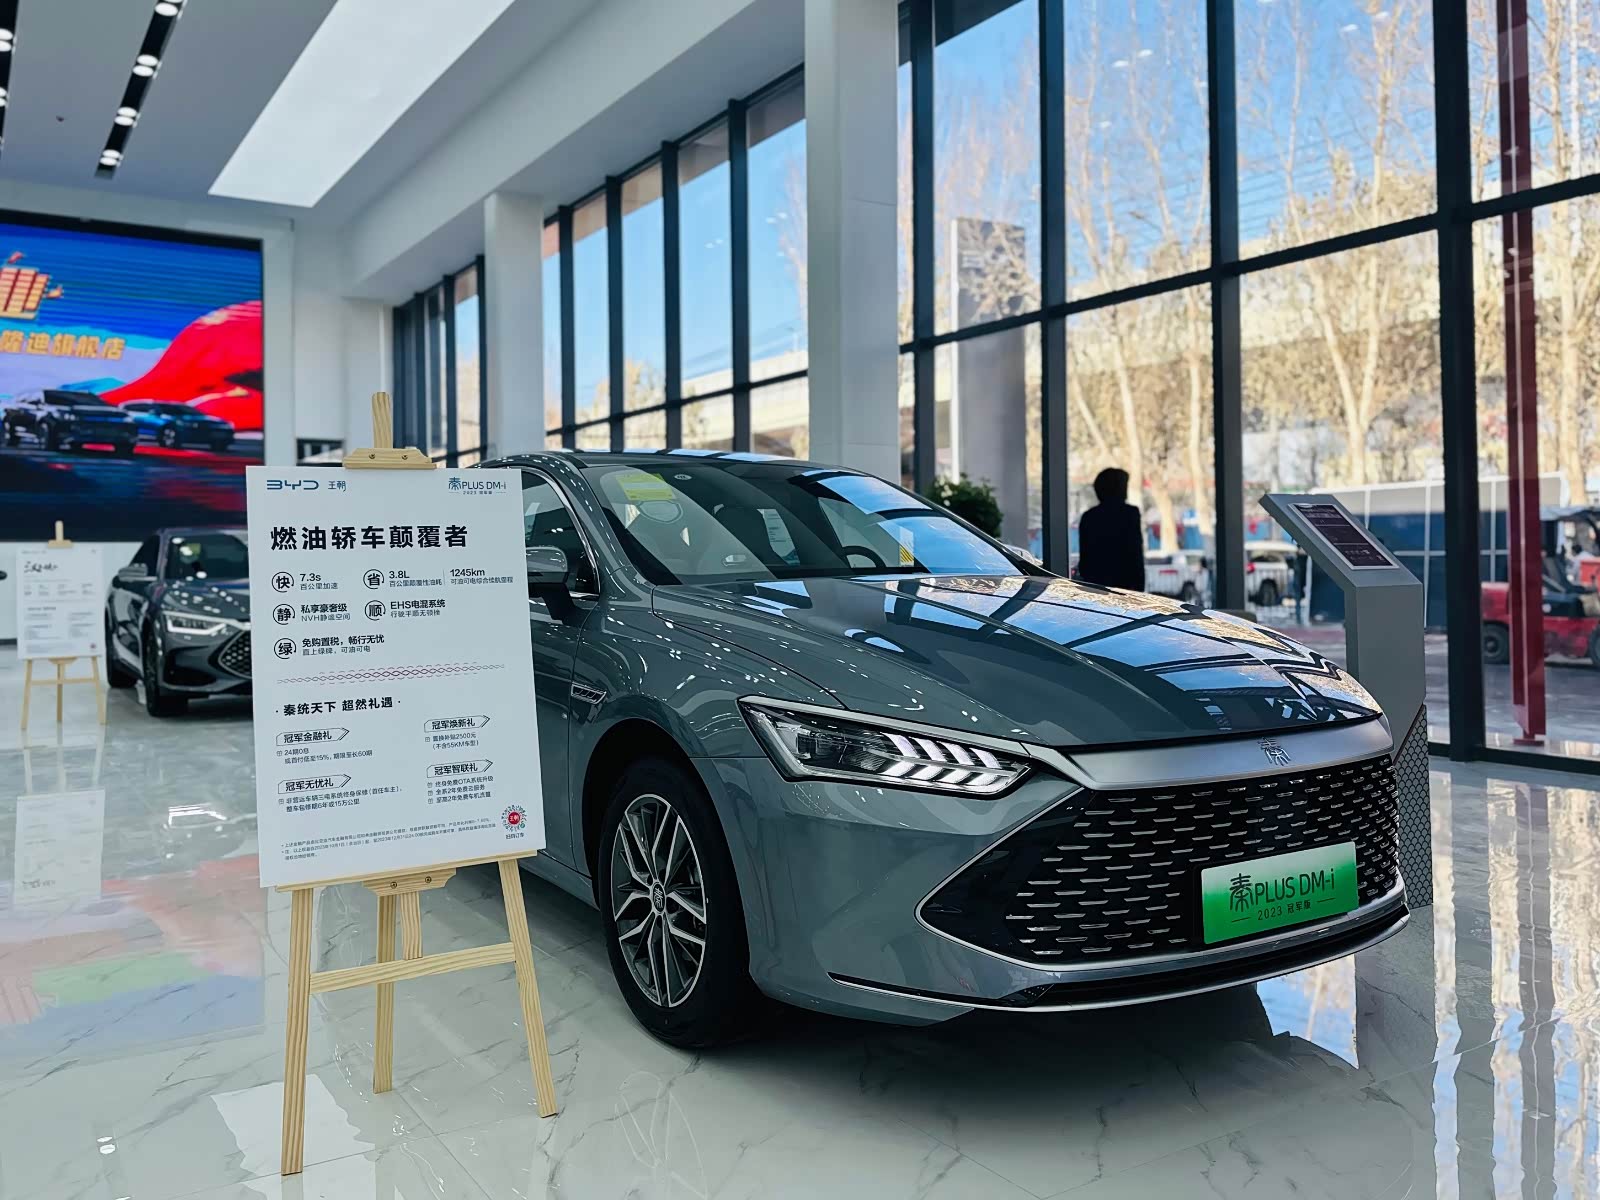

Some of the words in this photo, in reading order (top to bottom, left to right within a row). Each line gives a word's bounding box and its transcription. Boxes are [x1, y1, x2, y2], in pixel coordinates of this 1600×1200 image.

[266, 480, 319, 490] BYD
[270, 525, 468, 551] 燃油轿车颠覆者
[300, 573, 321, 582] 7.3s
[389, 571, 410, 579] 3.8L
[450, 568, 485, 577] 1245km
[276, 576, 290, 590] 快
[300, 582, 338, 590] 百公里加速
[367, 573, 380, 586] 省
[368, 604, 382, 617] 顺
[390, 599, 446, 609] EHS电混系统
[277, 608, 291, 621] 静
[302, 634, 385, 648] 免购置税，畅行无忧
[279, 643, 293, 655] 绿
[283, 701, 336, 716] 秦统天下
[342, 697, 393, 711] 超然礼遇
[432, 718, 475, 730] 冠军焕新礼
[284, 730, 332, 743] 冠军金融礼
[434, 763, 478, 776] 冠军智联礼
[286, 778, 333, 792] 冠军无忧礼
[1229, 872, 1295, 912] 秦PLUS
[1299, 868, 1335, 896] DM-i
[1257, 905, 1283, 920] 2023
